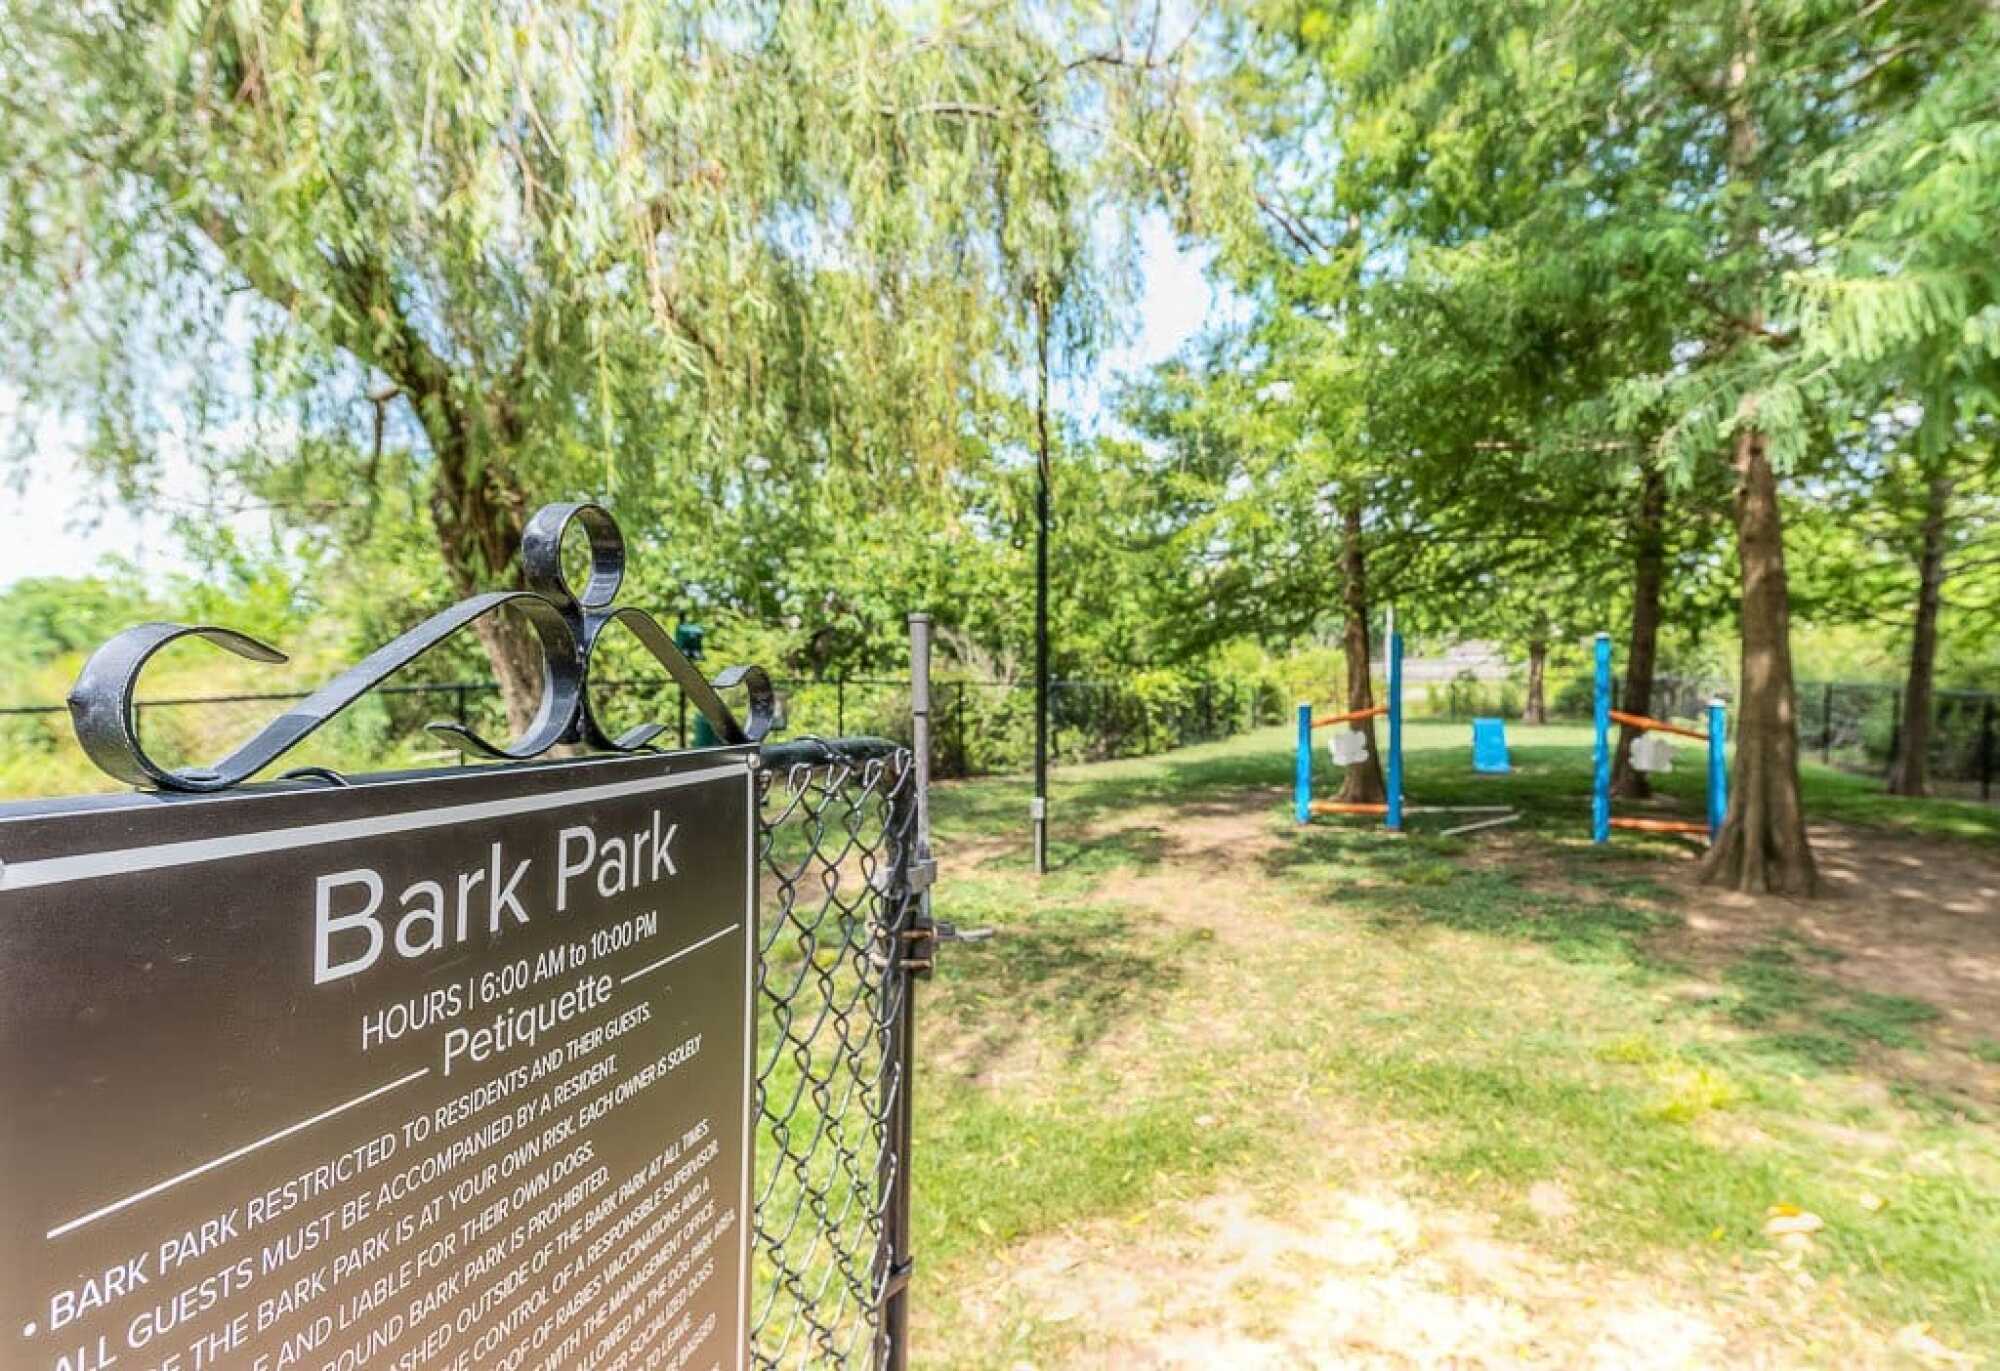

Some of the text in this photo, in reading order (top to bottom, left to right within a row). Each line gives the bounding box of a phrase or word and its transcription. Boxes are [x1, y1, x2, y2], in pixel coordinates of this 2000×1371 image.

[314, 809, 678, 985] Bark Park
[362, 983, 462, 1051] HOURS
[481, 960, 528, 1004] 6:00
[533, 944, 566, 985] AM
[569, 941, 586, 967] to
[590, 919, 632, 962] 10:00
[634, 910, 658, 942] PM
[443, 973, 613, 1077] Petiquette
[50, 1252, 149, 1331] BARK
[159, 1208, 239, 1276] PARK
[247, 1133, 396, 1230] RESTRICTED
[402, 1116, 429, 1148] TO
[434, 1066, 528, 1133] RESIDENTS
[531, 1048, 563, 1081] AND
[566, 1026, 603, 1062] THEIR
[127, 1256, 253, 1348] GUESTS
[262, 1210, 337, 1276] MUST
[342, 1191, 371, 1231] BE
[376, 1115, 512, 1211] ACCOMPANIED
[516, 1098, 538, 1129] BY
[540, 1092, 551, 1116] A
[553, 1054, 618, 1107] RESIDENT.
[189, 1311, 249, 1371] THE
[257, 1267, 327, 1332] BARK
[333, 1228, 390, 1284] PARK
[396, 1214, 415, 1245] IS
[419, 1195, 444, 1231] AT
[448, 1163, 498, 1211] YOUR
[501, 1136, 540, 1178] OWN
[579, 1092, 614, 1128] EACH
[614, 1063, 656, 1104] OWNER
[457, 1261, 529, 1333] OUTSIDE
[532, 1241, 553, 1274] OF
[556, 1218, 583, 1254] THE
[585, 1191, 618, 1233] BARK
[618, 1166, 648, 1205] PARK
[648, 1155, 663, 1181] AT
[277, 1315, 332, 1371] AND
[339, 1260, 412, 1329] LIABLE
[417, 1232, 456, 1278] FOR
[461, 1195, 509, 1245] THEIR
[513, 1168, 550, 1211] OWN
[409, 1272, 460, 1328] BARK
[464, 1236, 507, 1288] PARK
[511, 1226, 525, 1253] IS
[474, 1286, 549, 1360] CONTROL
[552, 1263, 572, 1293] OF
[574, 1255, 585, 1278] A
[587, 1187, 664, 1266] RESPONSIBLE
[533, 1317, 554, 1349] OF
[556, 1275, 602, 1329] RABIES
